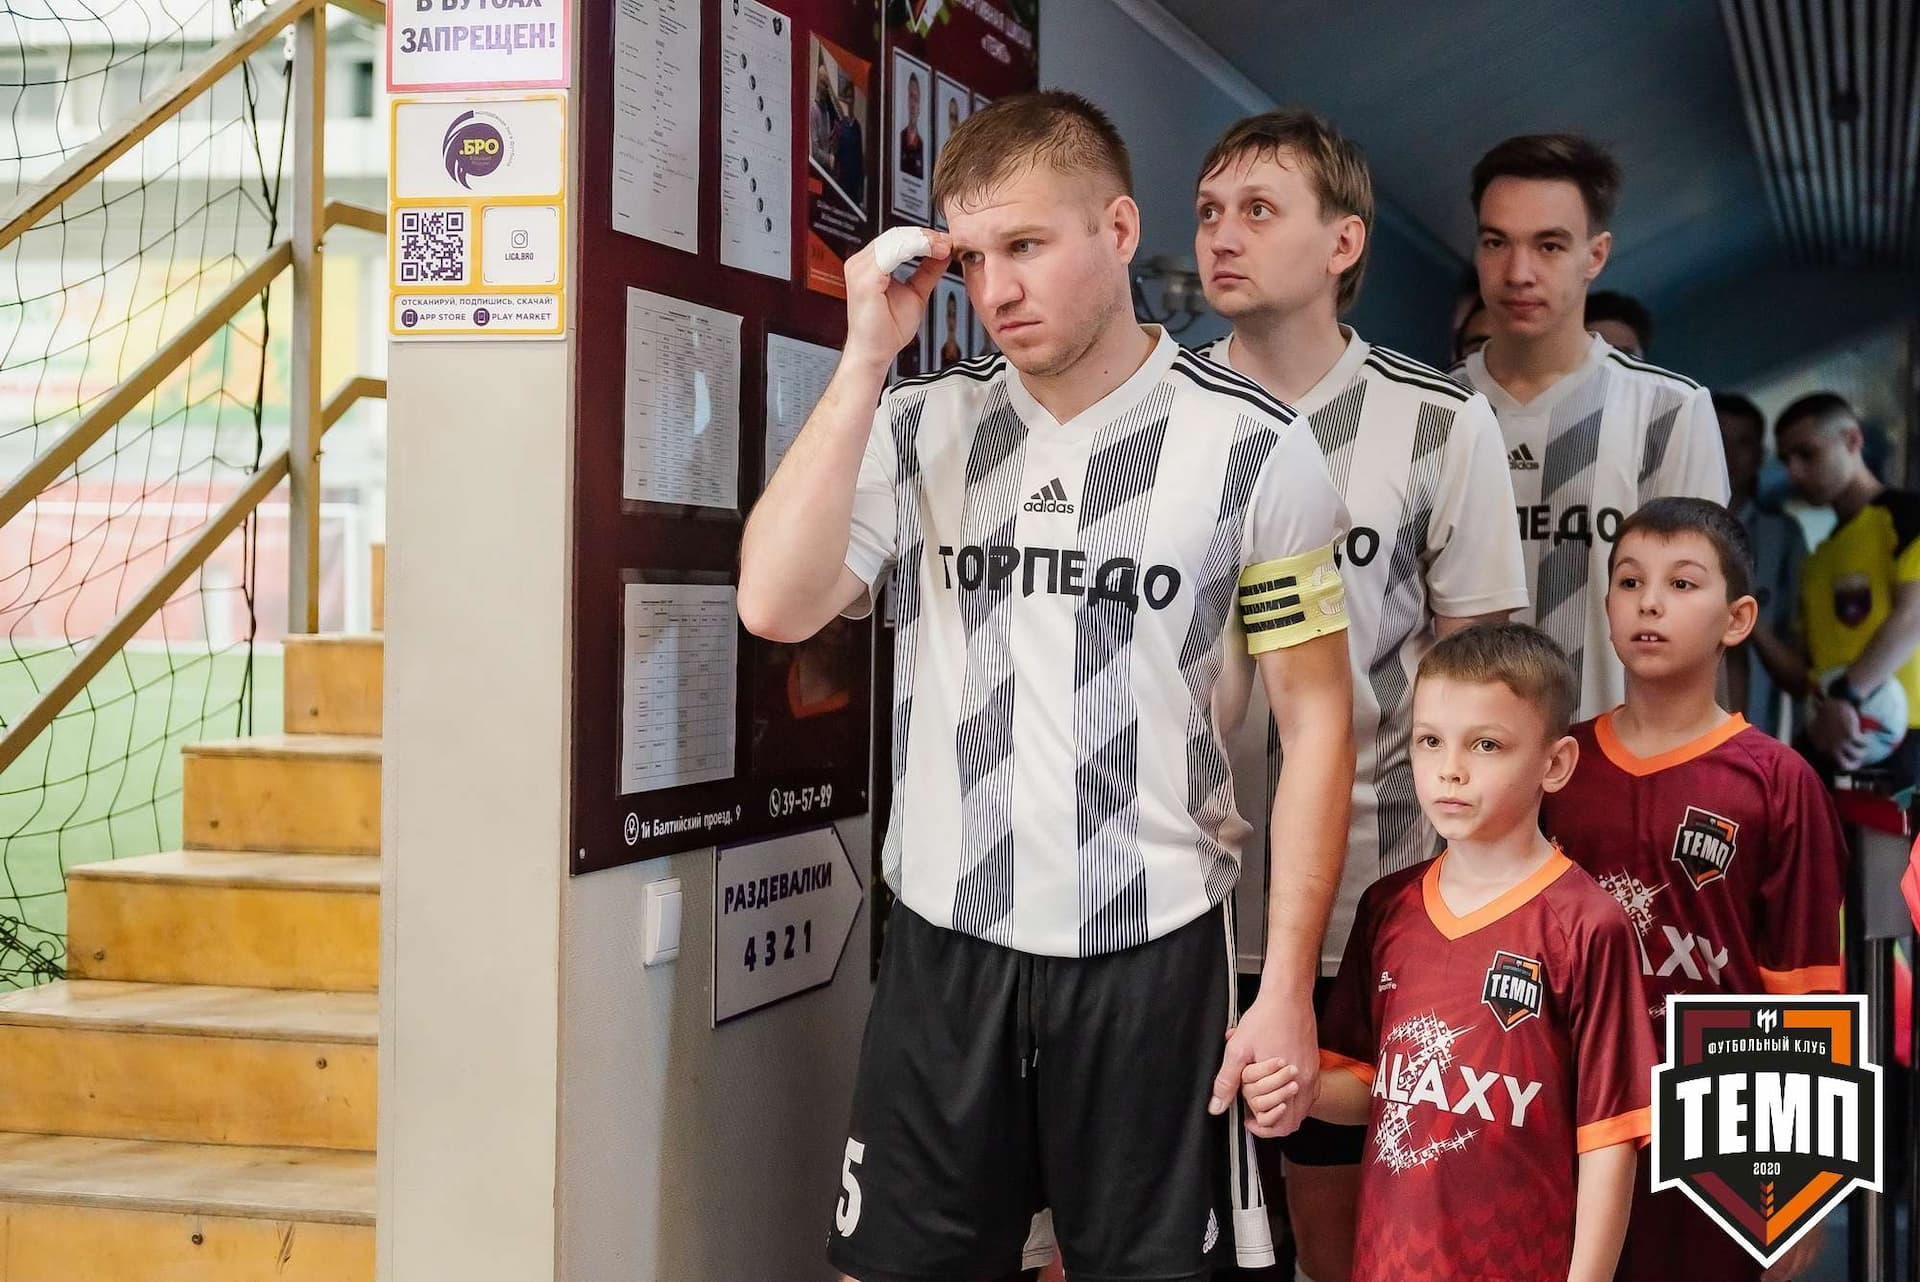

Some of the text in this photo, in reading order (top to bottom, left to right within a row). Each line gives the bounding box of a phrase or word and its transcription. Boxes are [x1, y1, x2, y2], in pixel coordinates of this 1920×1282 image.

[400, 22, 556, 55] ЗАПРЕЩЕН!
[401, 297, 553, 306] ОТСКАНИРУЙ, ПОДПИШИСЬ, СКАЧАЙ!
[438, 313, 467, 321] STORE
[492, 313, 552, 321] PLAY MARKET
[1023, 499, 1075, 514] adidas
[939, 545, 1182, 615] ТОРПЕДО
[782, 784, 832, 816] 39-57-29
[653, 812, 702, 837] Балтийский
[736, 804, 741, 821] 9
[1681, 830, 1730, 870] ТЕМП
[724, 862, 832, 914] РАЗДЕВАЛКИ
[744, 920, 811, 972] 4 3 2 1
[1490, 973, 1538, 1009] ТЕМП
[1371, 1051, 1543, 1128] ALAXY
